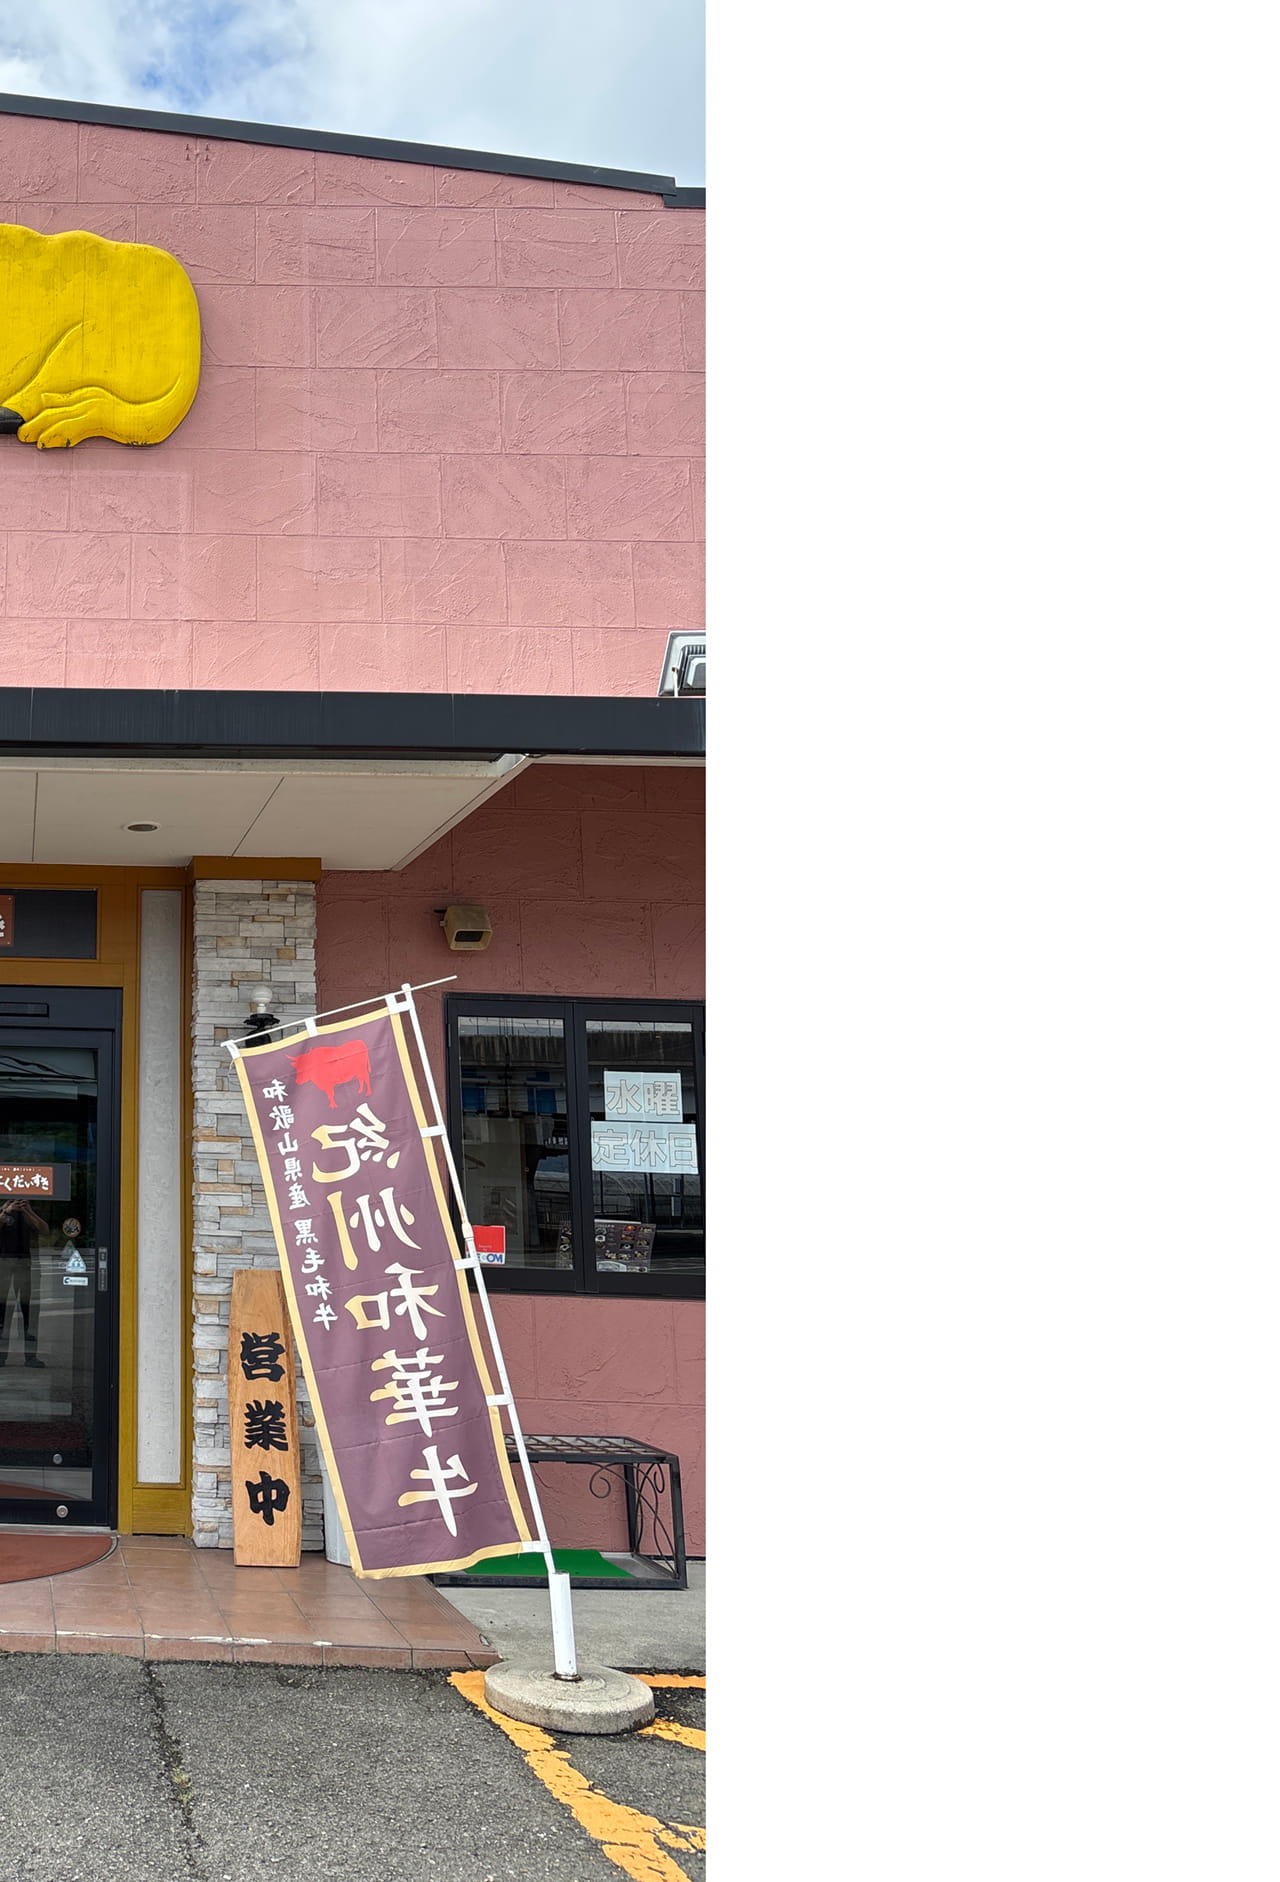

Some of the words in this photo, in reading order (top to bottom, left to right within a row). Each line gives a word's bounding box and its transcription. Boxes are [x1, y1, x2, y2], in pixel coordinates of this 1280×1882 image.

[606, 1079, 681, 1116] 水曜
[593, 1129, 698, 1168] 定休日
[240, 1332, 291, 1526] 営業中
